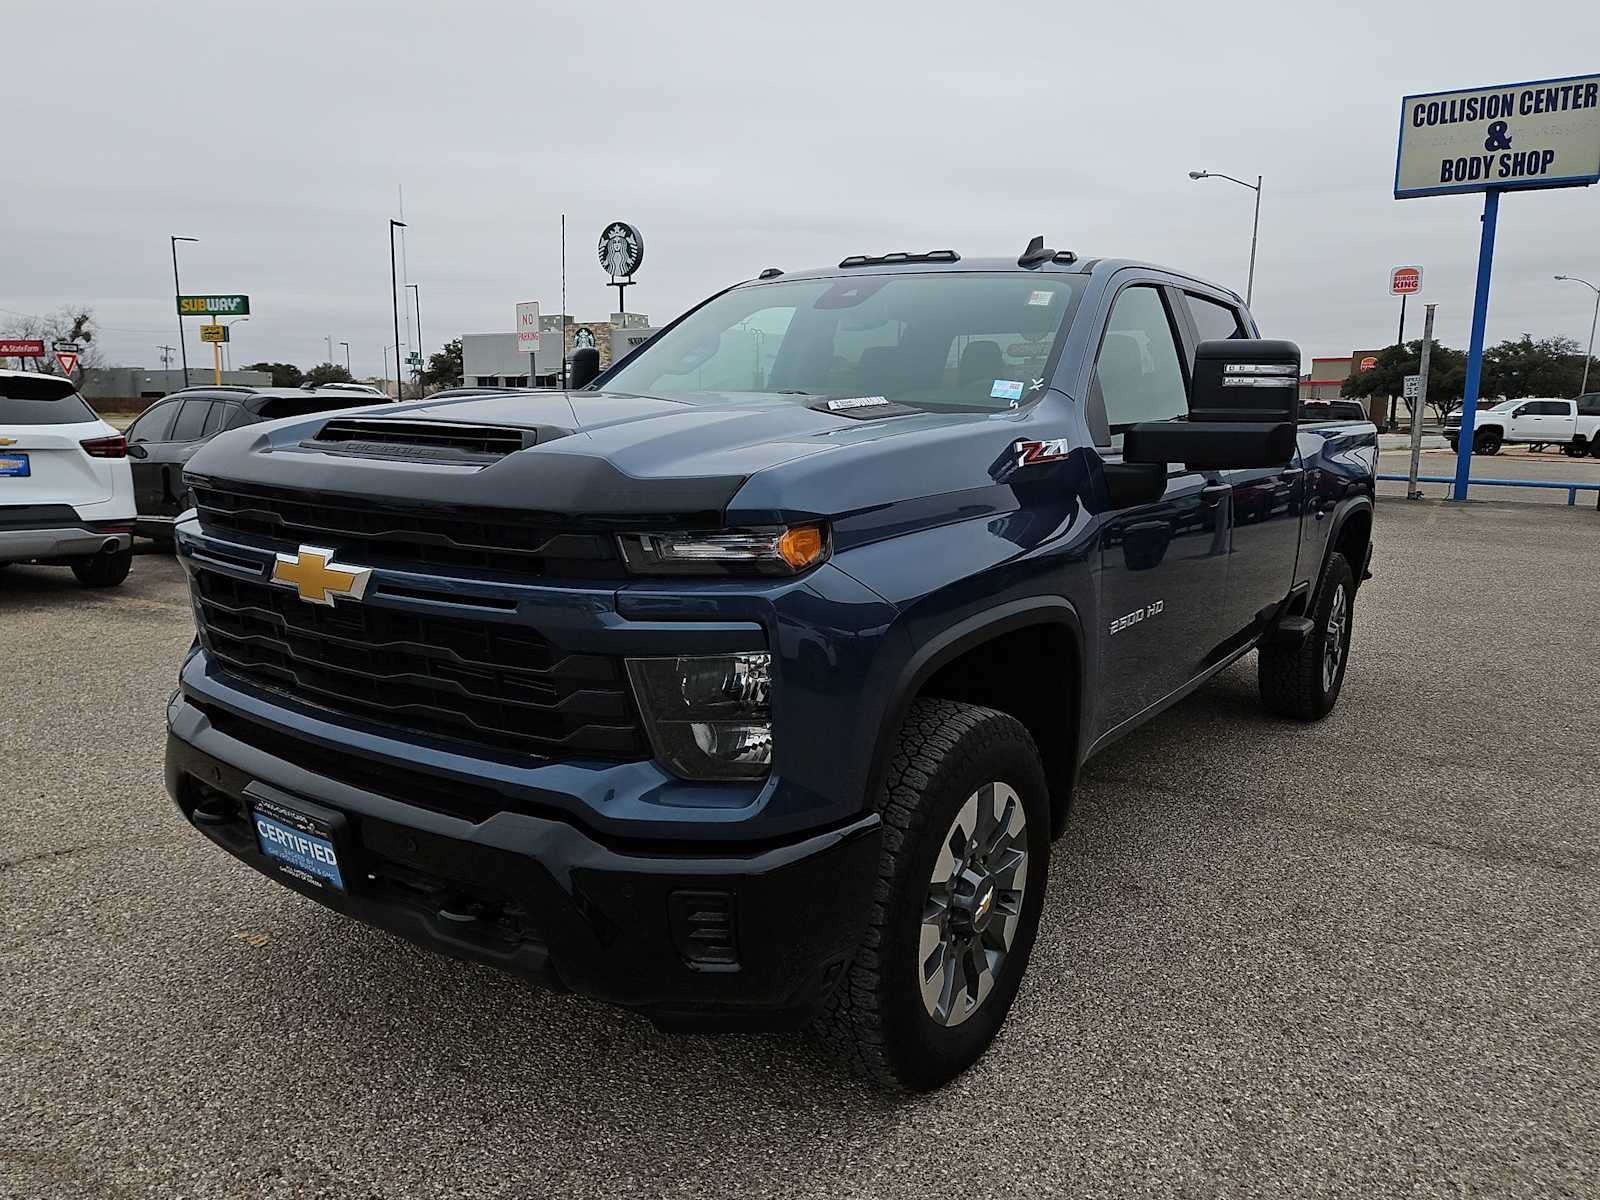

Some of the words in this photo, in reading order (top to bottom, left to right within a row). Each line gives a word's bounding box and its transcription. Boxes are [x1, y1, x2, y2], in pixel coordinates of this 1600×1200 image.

[1412, 93, 1514, 127] COLLISION
[1519, 83, 1599, 116] CENTER
[1484, 120, 1513, 152] &
[1439, 155, 1495, 183] BODY
[1498, 150, 1555, 178] SHOP
[1393, 280, 1418, 289] KING
[180, 297, 241, 312] SUBWAY
[522, 313, 534, 325] NO
[518, 331, 539, 342] PARKING
[1109, 608, 1145, 635] 2500
[1146, 599, 1164, 618] HD
[257, 820, 338, 866] CERTIFIED
